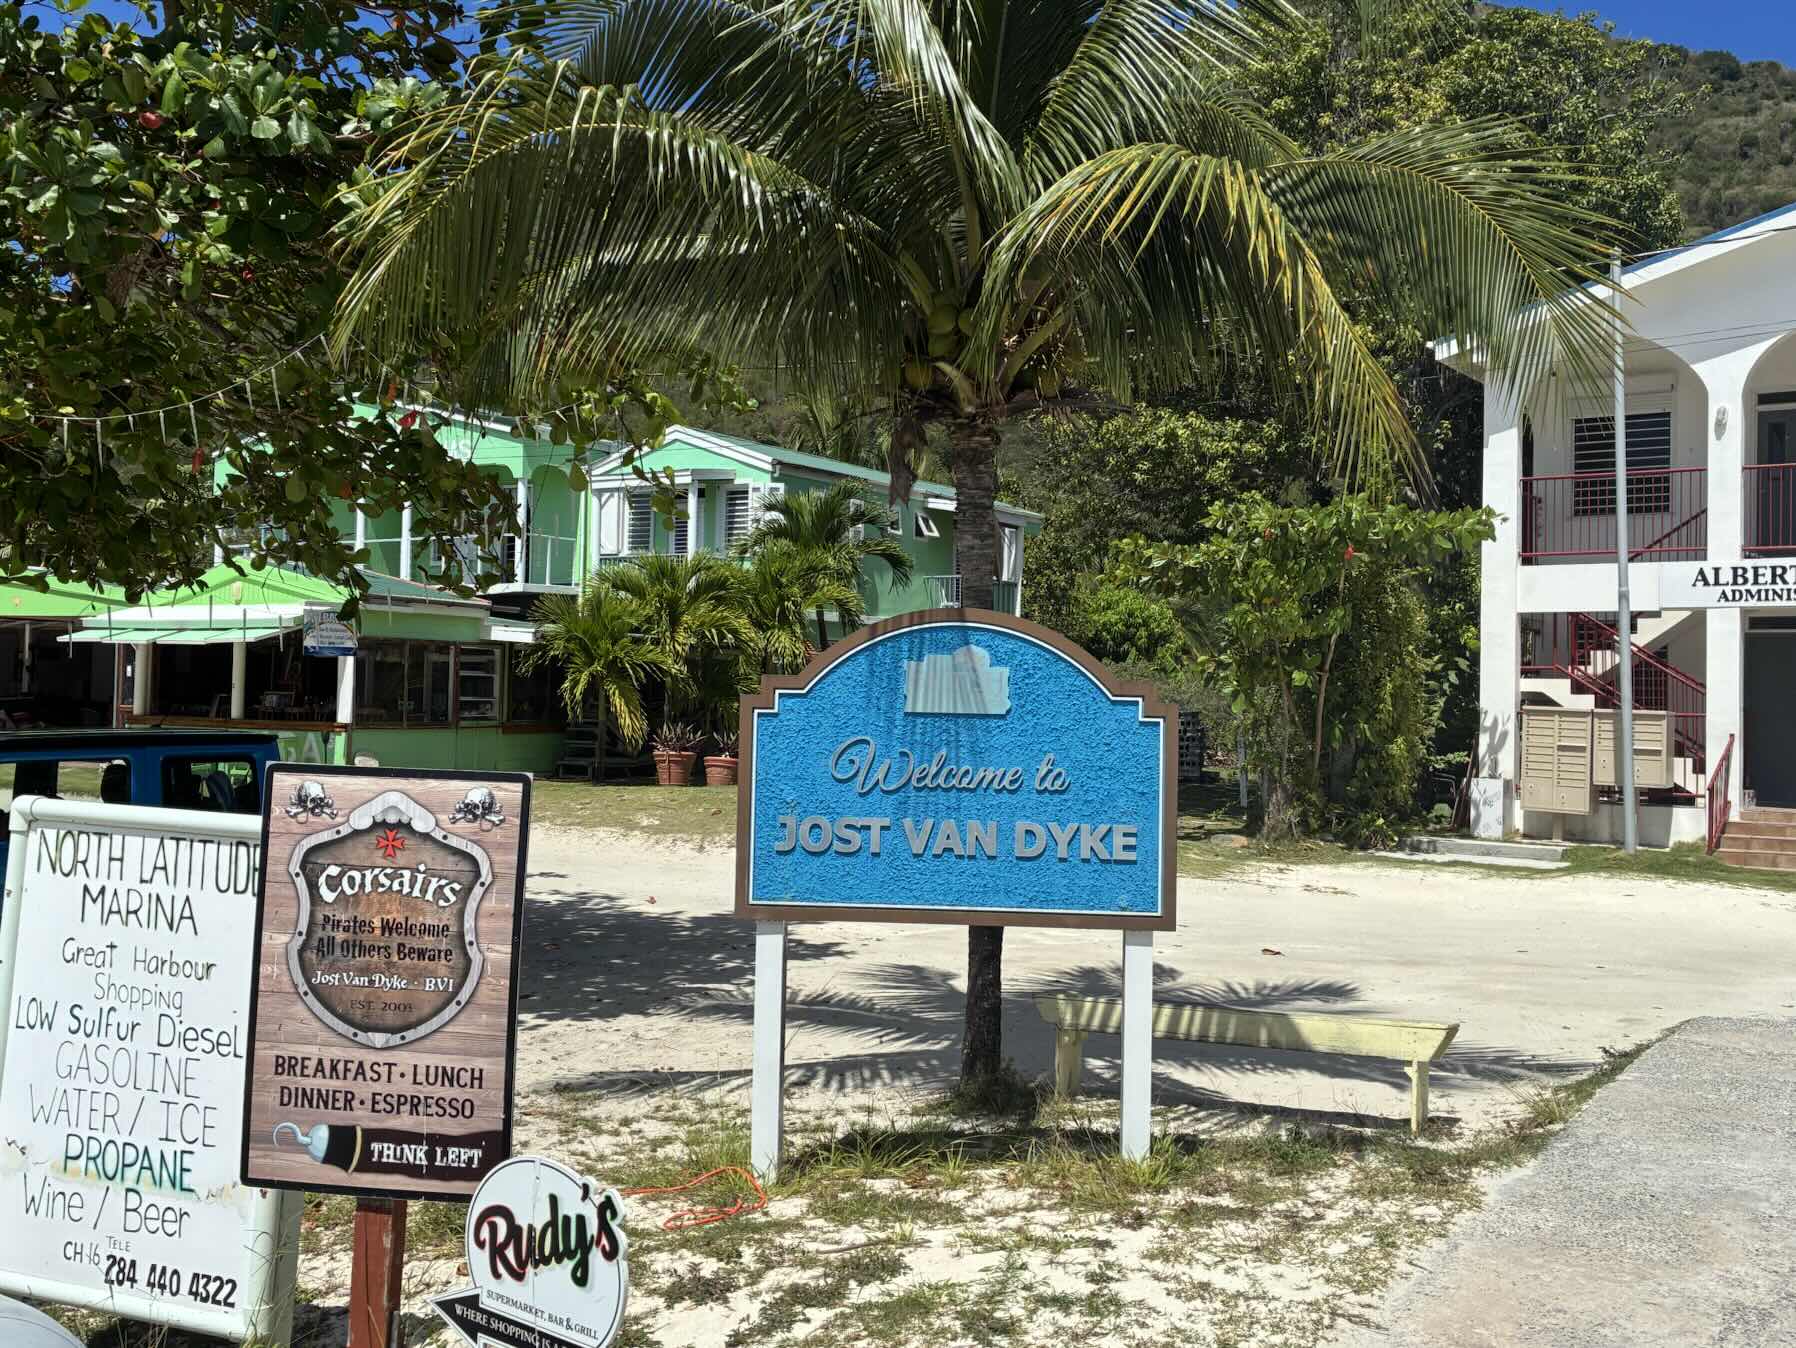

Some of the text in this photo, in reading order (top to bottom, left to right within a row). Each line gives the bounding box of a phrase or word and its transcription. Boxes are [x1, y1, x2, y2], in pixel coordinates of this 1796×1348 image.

[1717, 588, 1796, 603] ADMINI
[831, 736, 1071, 794] Welcome to
[36, 829, 126, 882] NORTH
[775, 815, 1138, 862] JOST VAN DYKE
[318, 864, 462, 907] Corsairs
[80, 883, 199, 936] MARINA
[321, 914, 450, 939] Pirates Welcome
[62, 937, 217, 981] Great Harbour
[315, 936, 453, 963] All Others Beware
[311, 970, 455, 992] Jost Van Dyke BVI
[16, 996, 58, 1032] LOW
[68, 1004, 141, 1042] Sulfur
[55, 1040, 201, 1099] GASOLINE
[274, 1054, 484, 1090] BREAKFAST LUNCH
[29, 1083, 121, 1135] WATER
[158, 1099, 218, 1148] ICE
[279, 1085, 475, 1119] DINNER ESPRESSO
[63, 1133, 196, 1193] PROPANE
[370, 1142, 482, 1168] THINK LEFT
[23, 1172, 84, 1223] Wine
[123, 1188, 191, 1238] Beer
[473, 1183, 619, 1288] Rudy's
[104, 1254, 238, 1309] 284 440 4322
[454, 1303, 488, 1327] WHERE
[489, 1317, 540, 1346] SHOPPING
[486, 1289, 546, 1322] SUPERMARKET,
[547, 1312, 565, 1328] BAR
